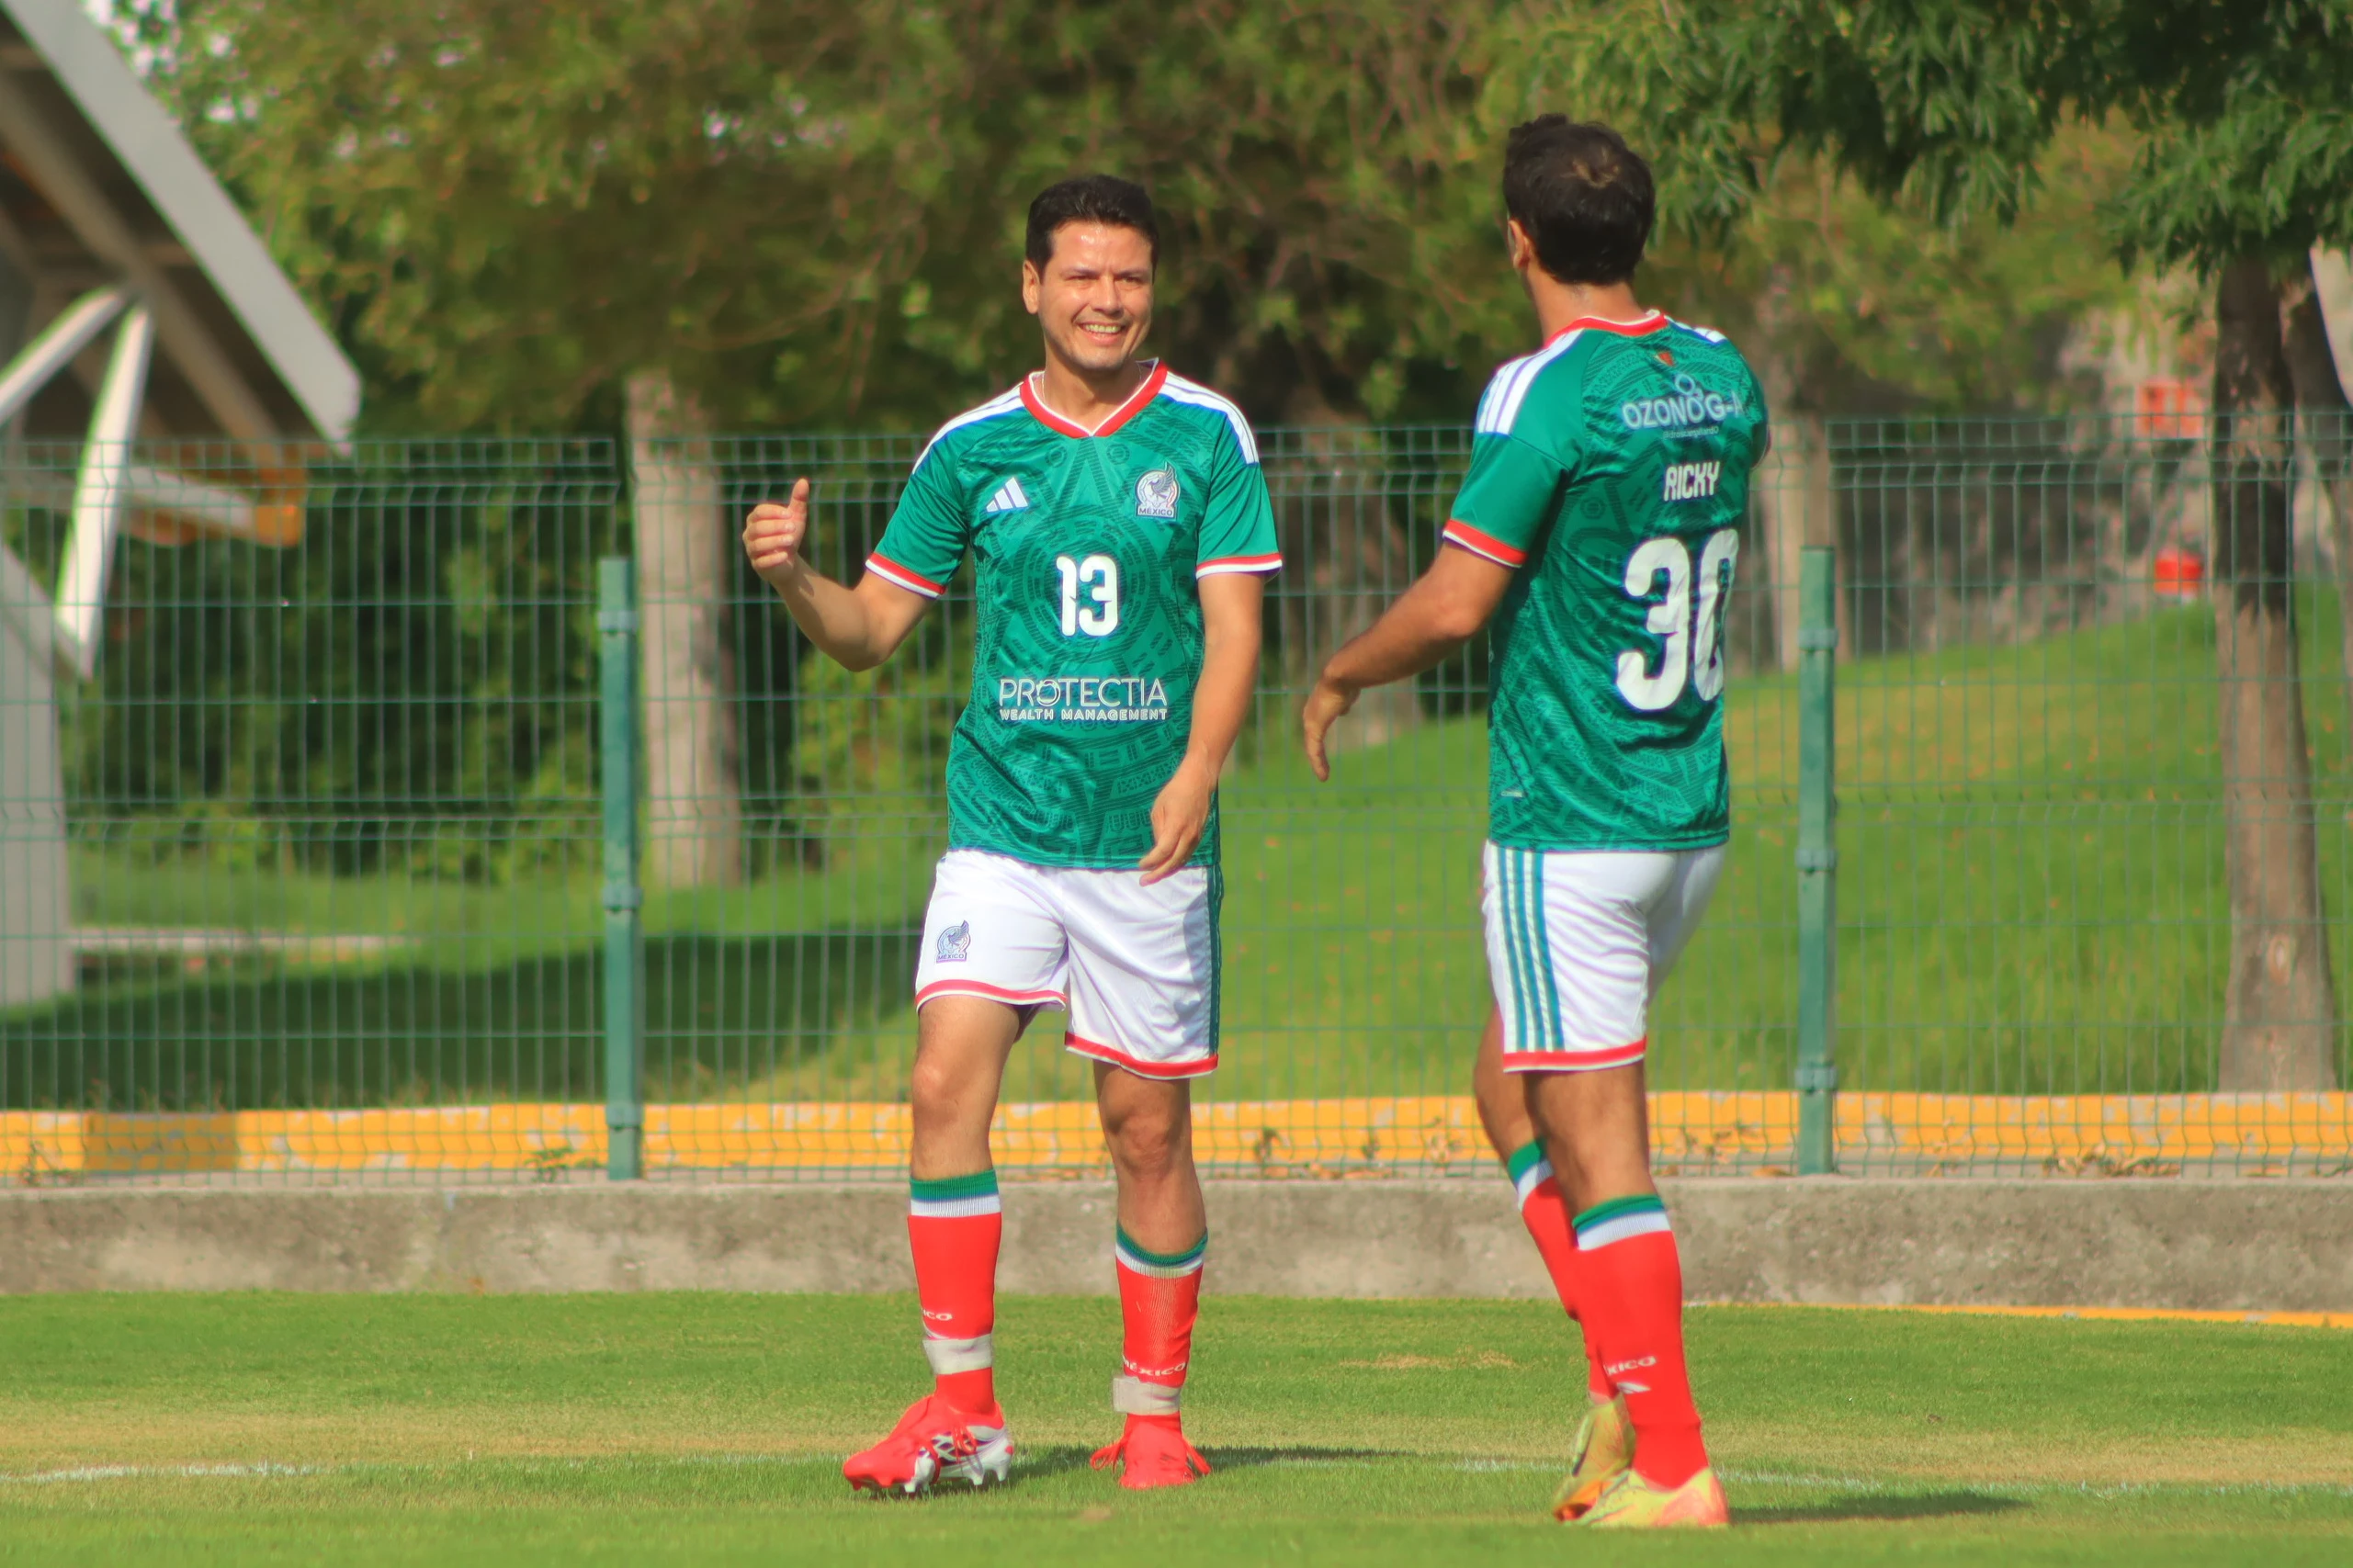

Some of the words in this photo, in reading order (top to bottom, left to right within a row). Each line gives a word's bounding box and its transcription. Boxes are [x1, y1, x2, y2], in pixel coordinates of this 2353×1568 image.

[1664, 461, 1720, 502] RICKY
[1057, 555, 1118, 636] 13
[1617, 528, 1738, 710] 30
[1000, 678, 1168, 706] PROTECTIA
[1000, 709, 1054, 720] WEALTH
[1061, 709, 1168, 720] MANAGEMENT
